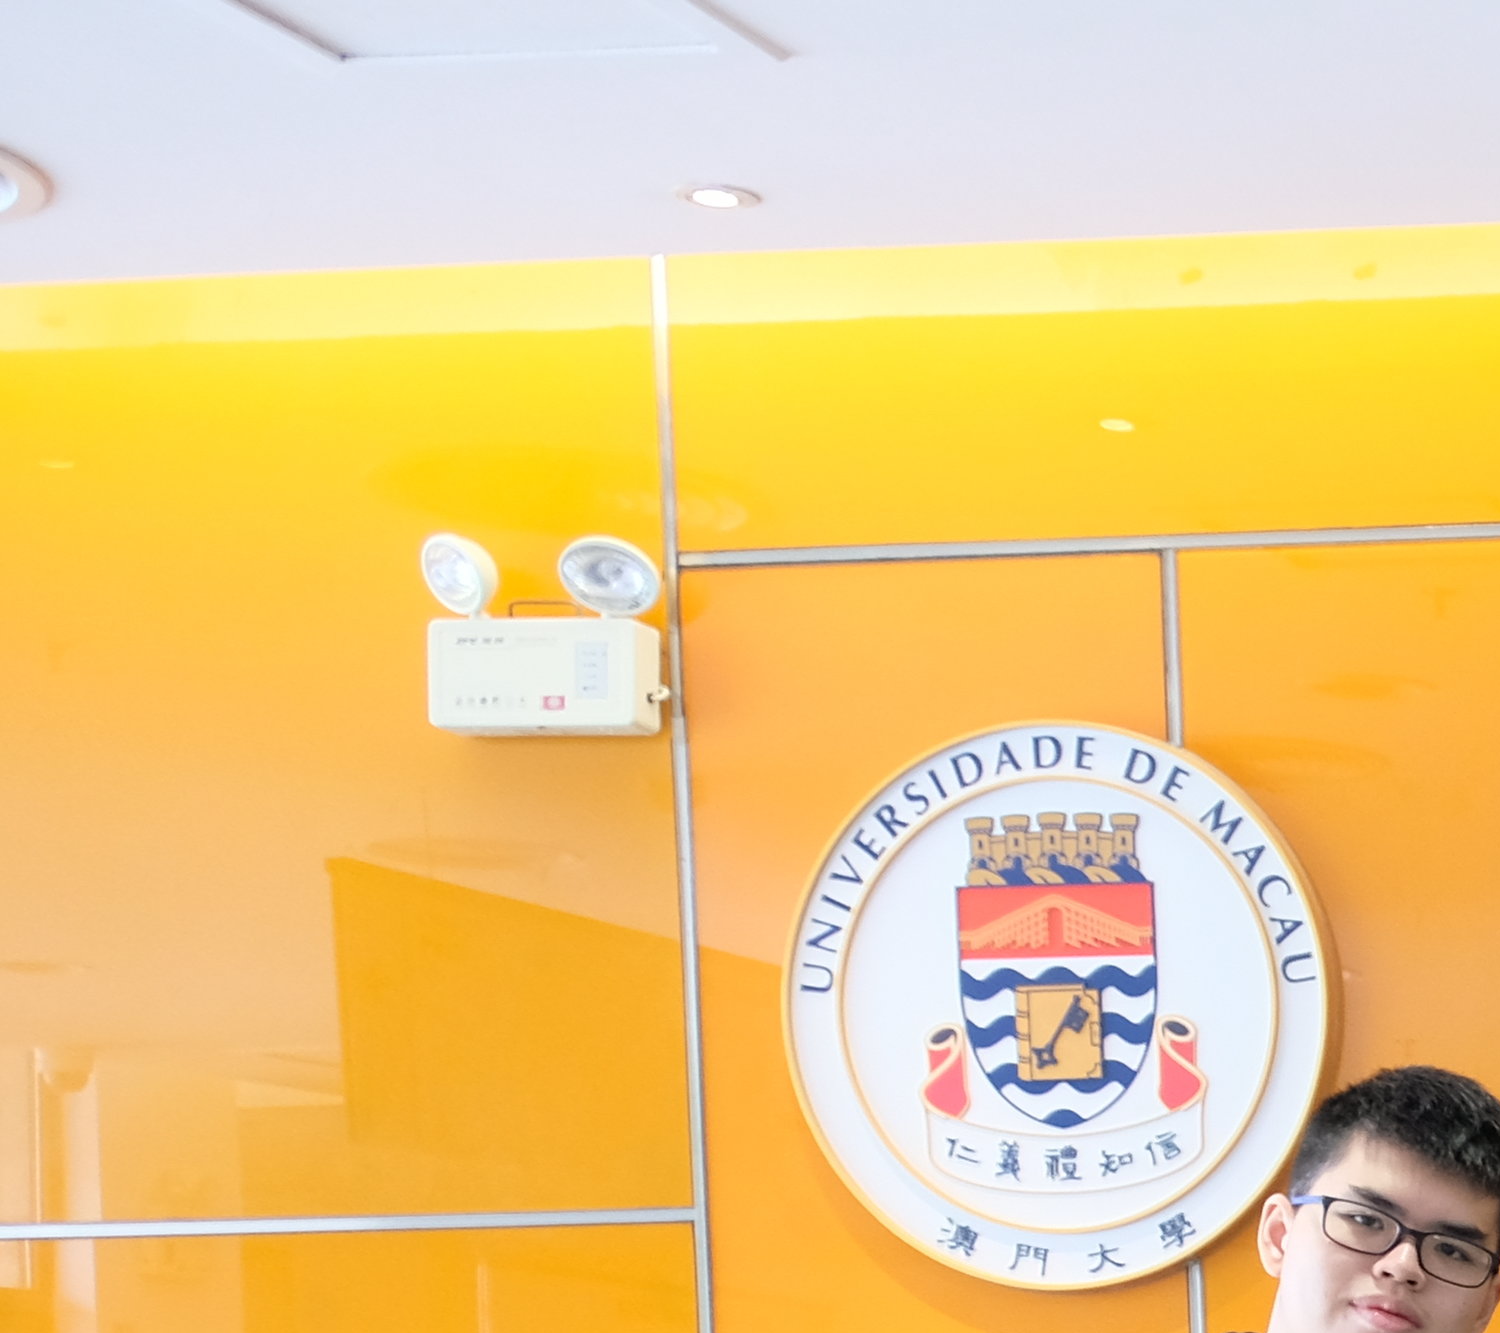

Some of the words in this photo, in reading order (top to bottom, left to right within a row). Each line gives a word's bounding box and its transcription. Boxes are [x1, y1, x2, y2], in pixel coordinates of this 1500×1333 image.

[800, 735, 1096, 993] UNIVERSIDADE
[1124, 747, 1191, 803] DE
[1199, 799, 1318, 985] MACAU
[936, 1211, 1198, 1277] 澳門大學
